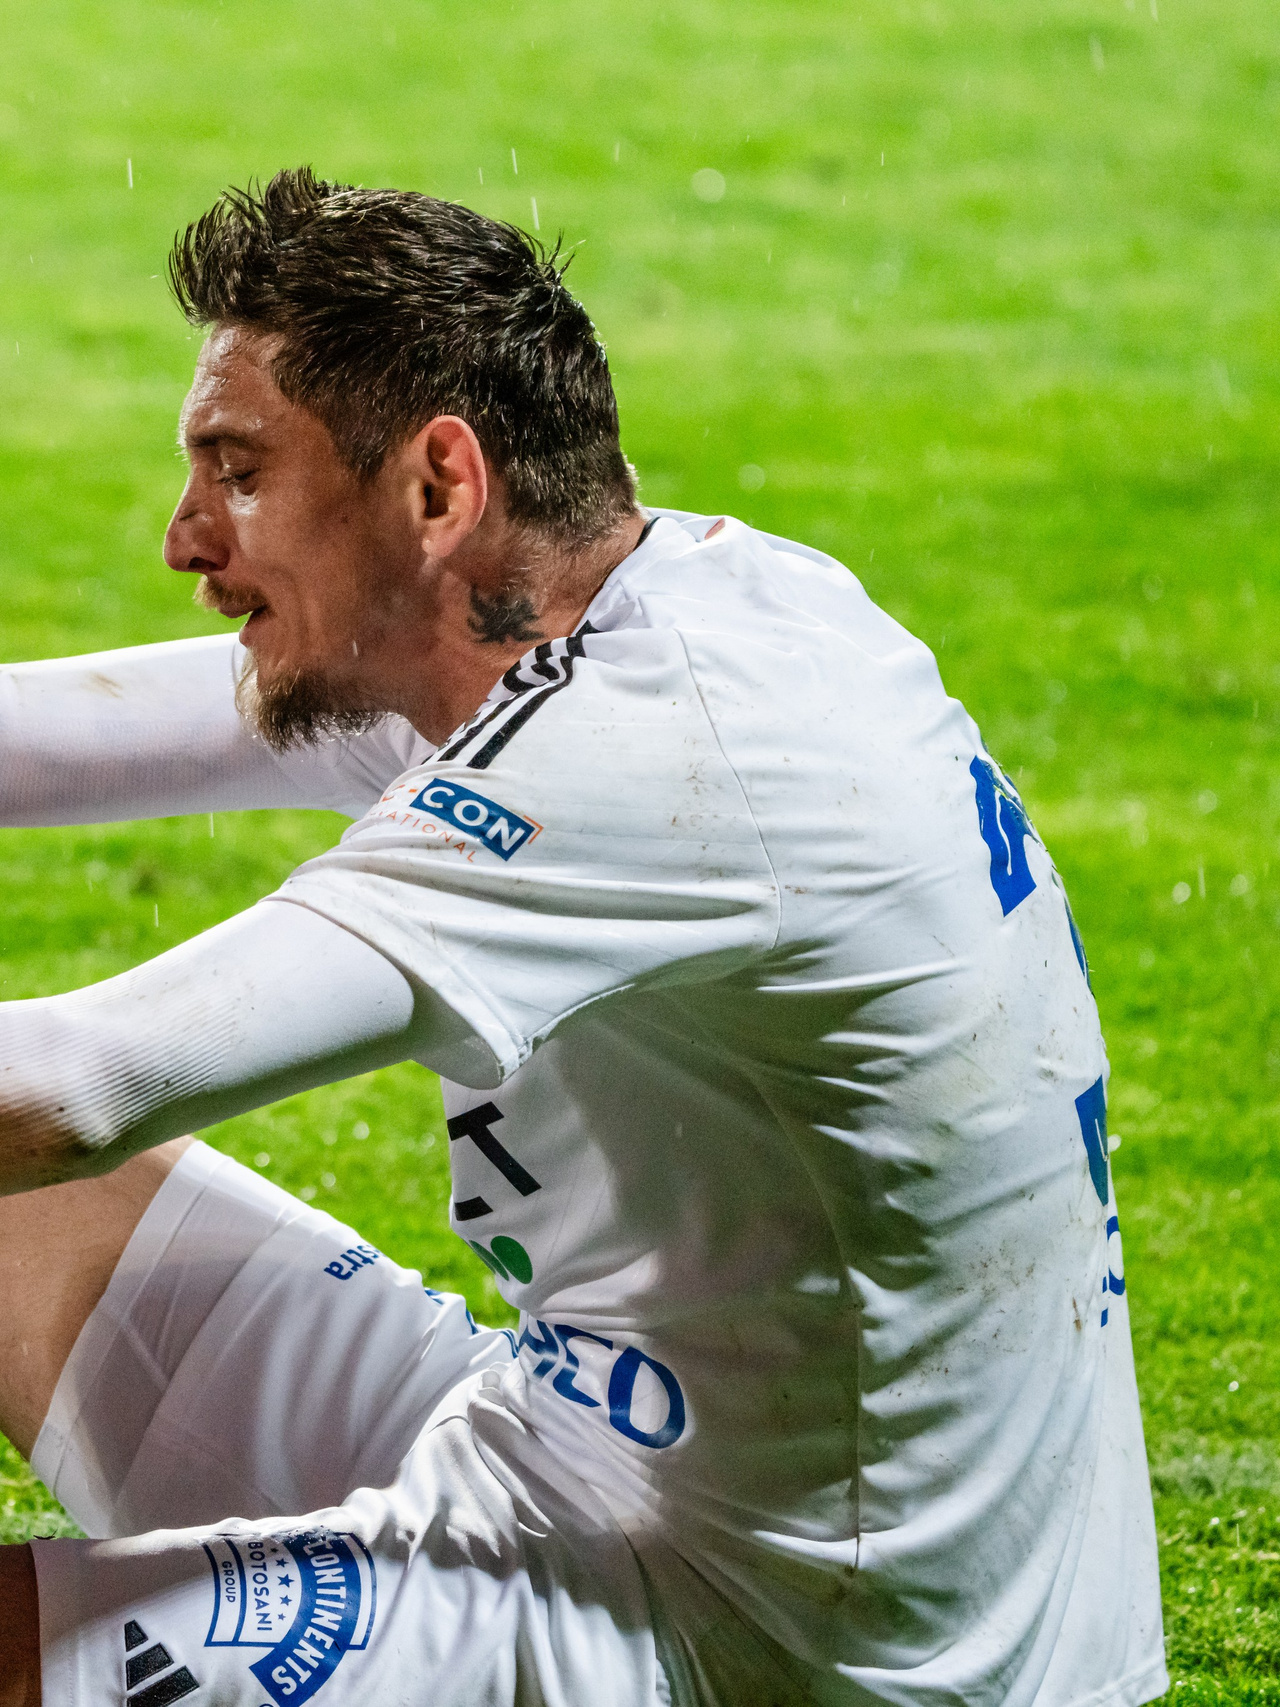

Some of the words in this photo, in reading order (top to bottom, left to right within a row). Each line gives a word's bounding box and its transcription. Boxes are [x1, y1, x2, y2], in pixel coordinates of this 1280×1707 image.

[373, 810, 476, 863] ATIONAL
[323, 1244, 382, 1281] stra
[221, 1560, 237, 1603] GROUP
[247, 1541, 273, 1631] BOTOSANI
[271, 1540, 347, 1696] CONTINENTS
